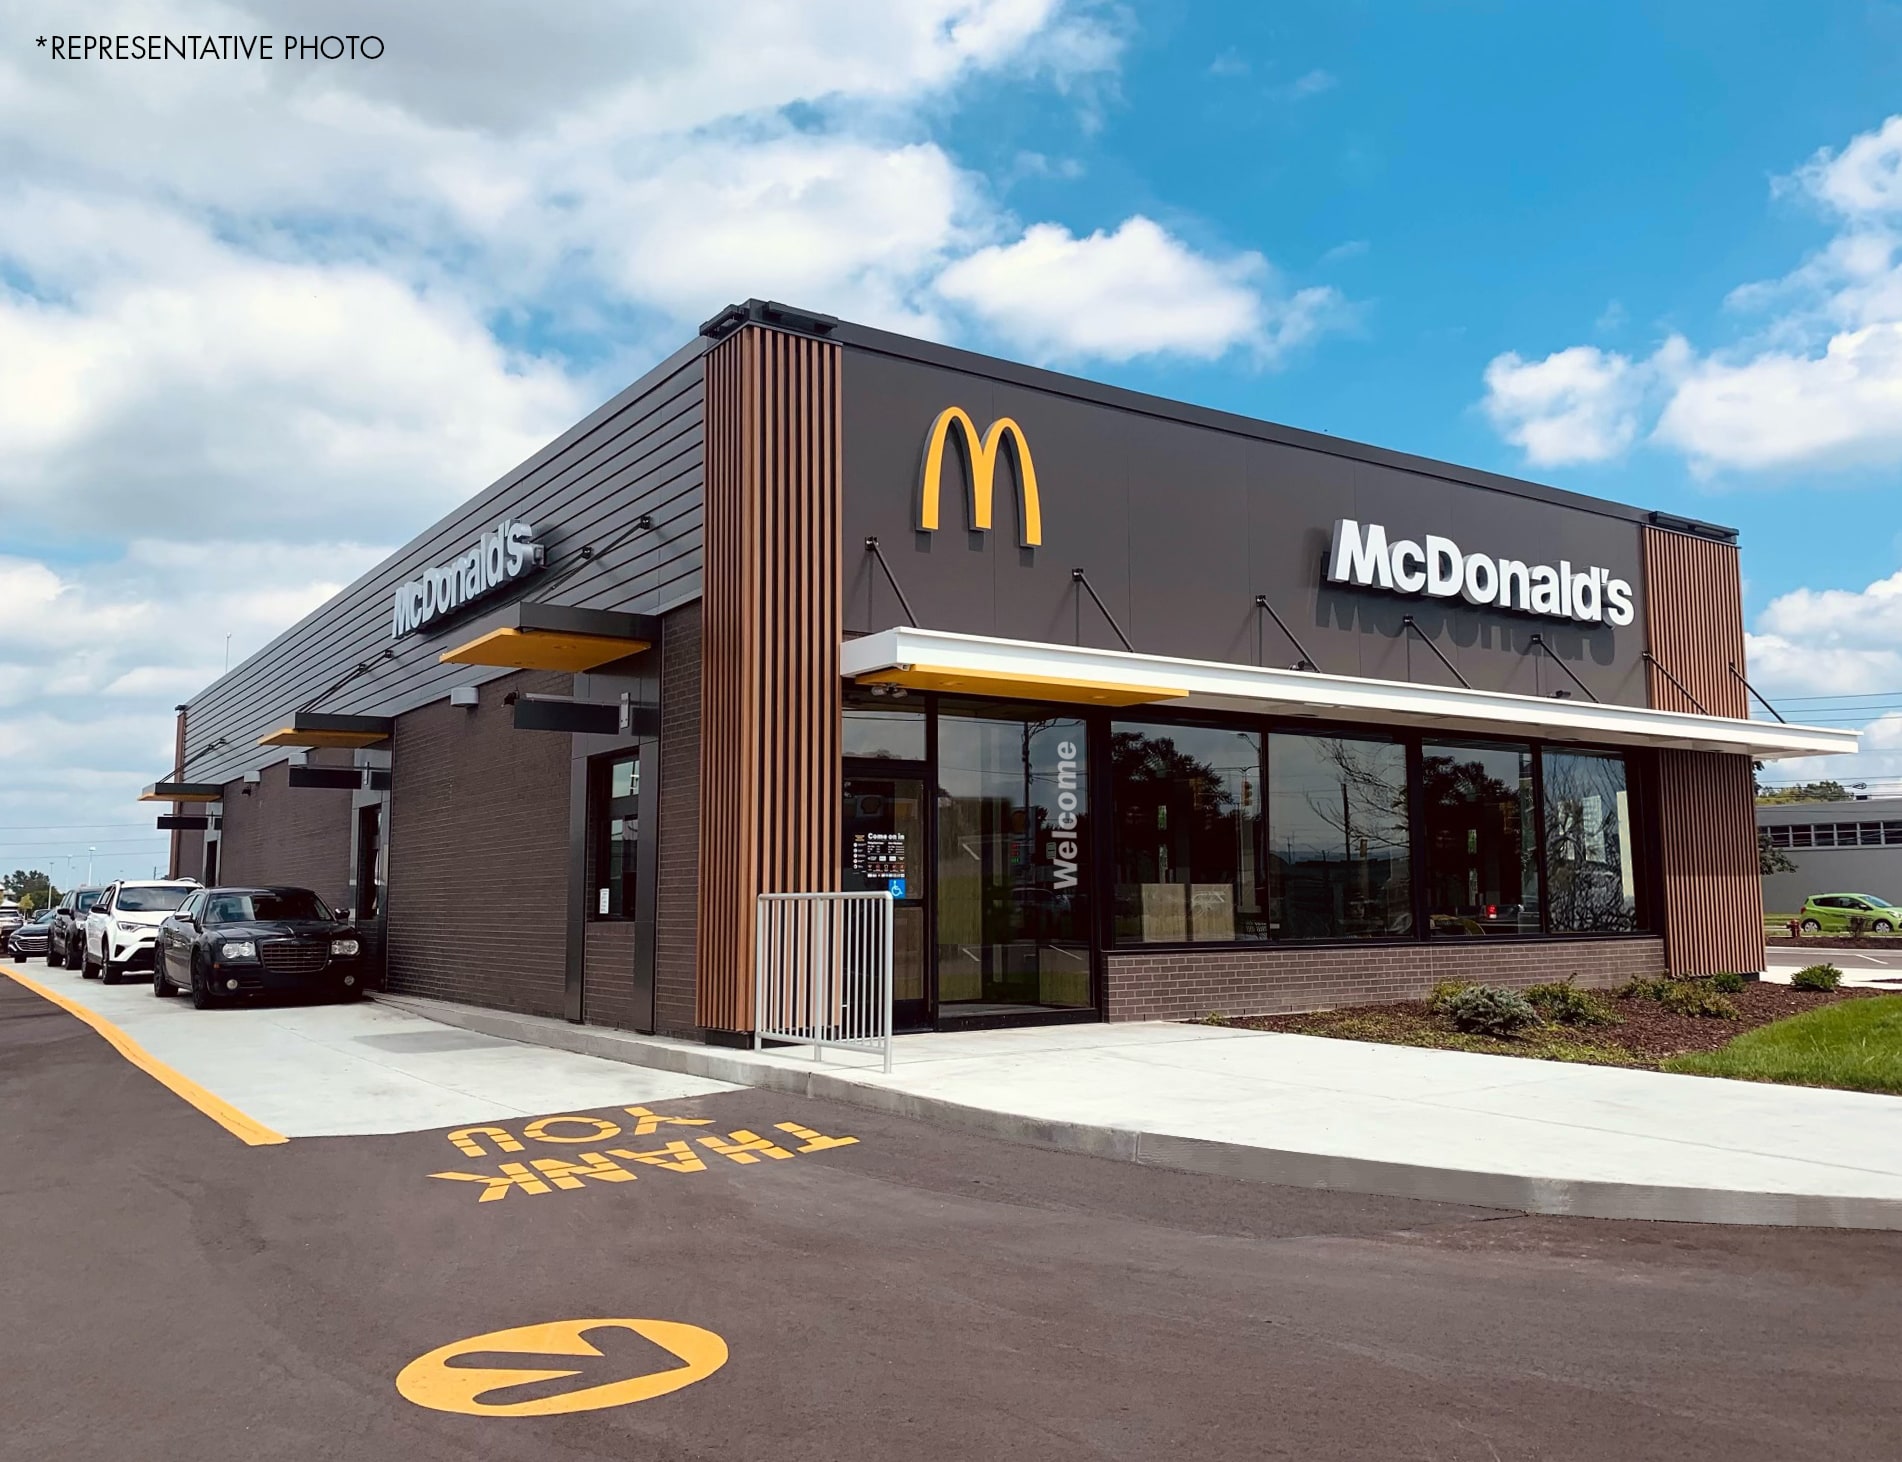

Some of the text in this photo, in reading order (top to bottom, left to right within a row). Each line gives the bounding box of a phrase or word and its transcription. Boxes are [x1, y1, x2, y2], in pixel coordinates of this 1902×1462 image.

[391, 519, 533, 639] McDonald's
[1327, 518, 1635, 629] McDonald's
[1052, 741, 1078, 889] Welcome
[425, 1121, 860, 1203] THANK
[447, 1106, 716, 1158] YOU
